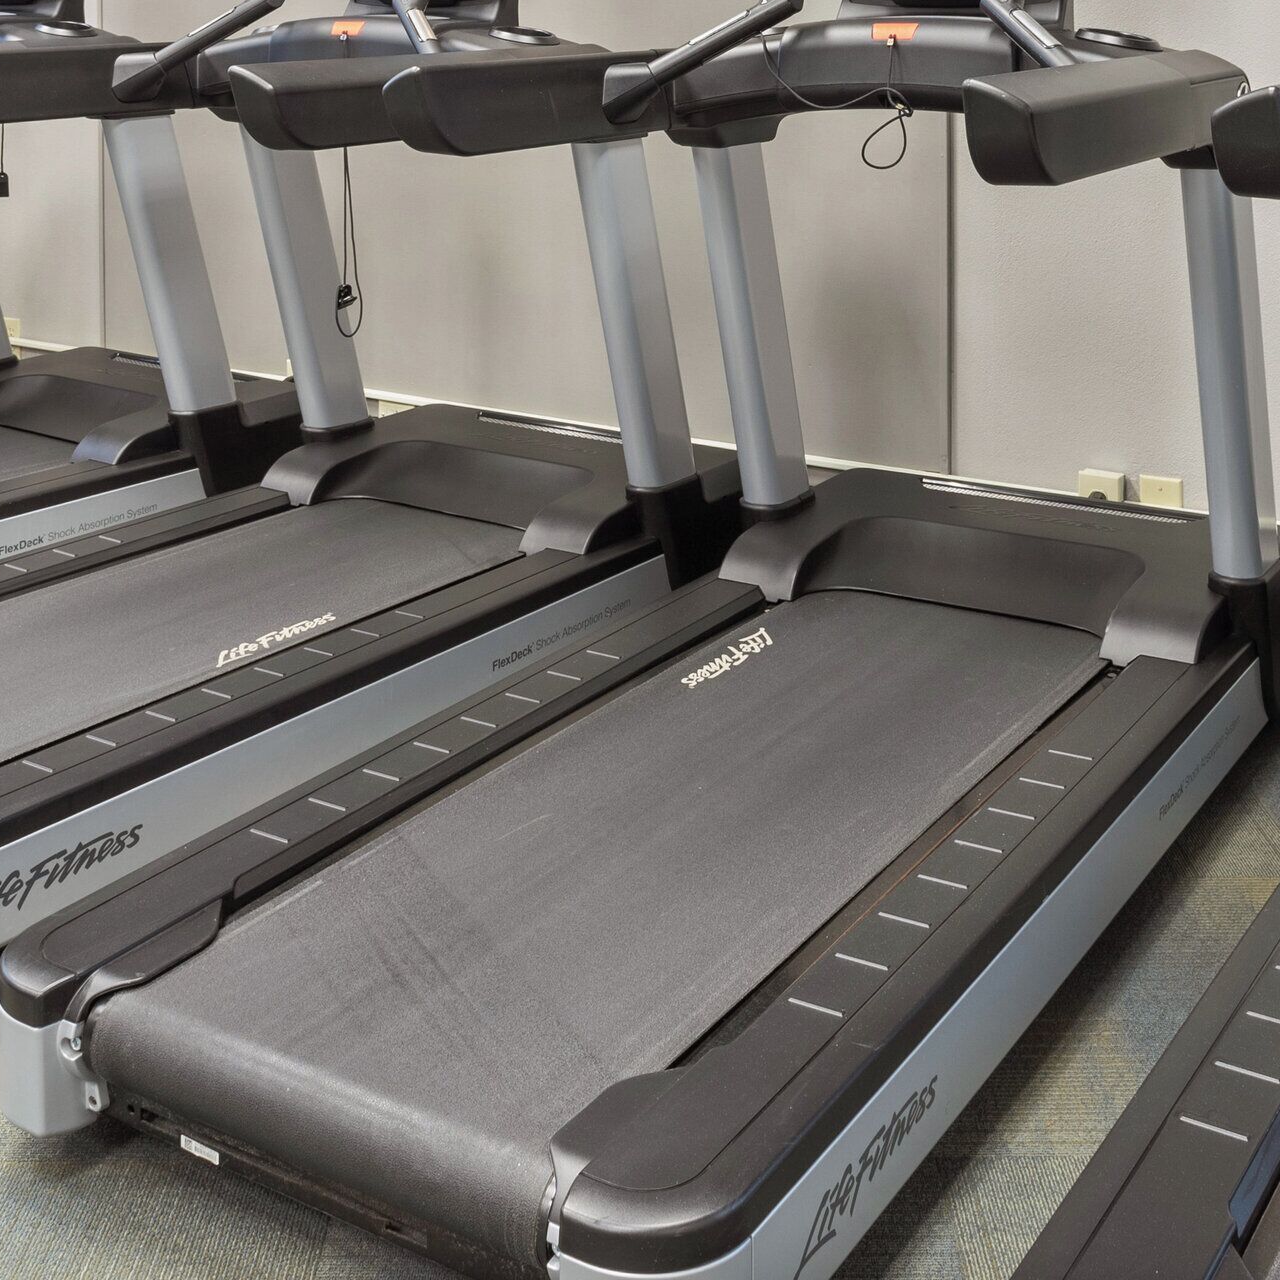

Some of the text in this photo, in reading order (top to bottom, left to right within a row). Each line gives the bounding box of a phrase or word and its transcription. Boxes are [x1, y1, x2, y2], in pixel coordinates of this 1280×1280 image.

[47, 527, 76, 543] Shock
[78, 513, 125, 533] Absorption
[126, 503, 158, 521] System
[536, 631, 561, 651] Shock
[561, 611, 603, 637] Absorption
[604, 598, 631, 619] System
